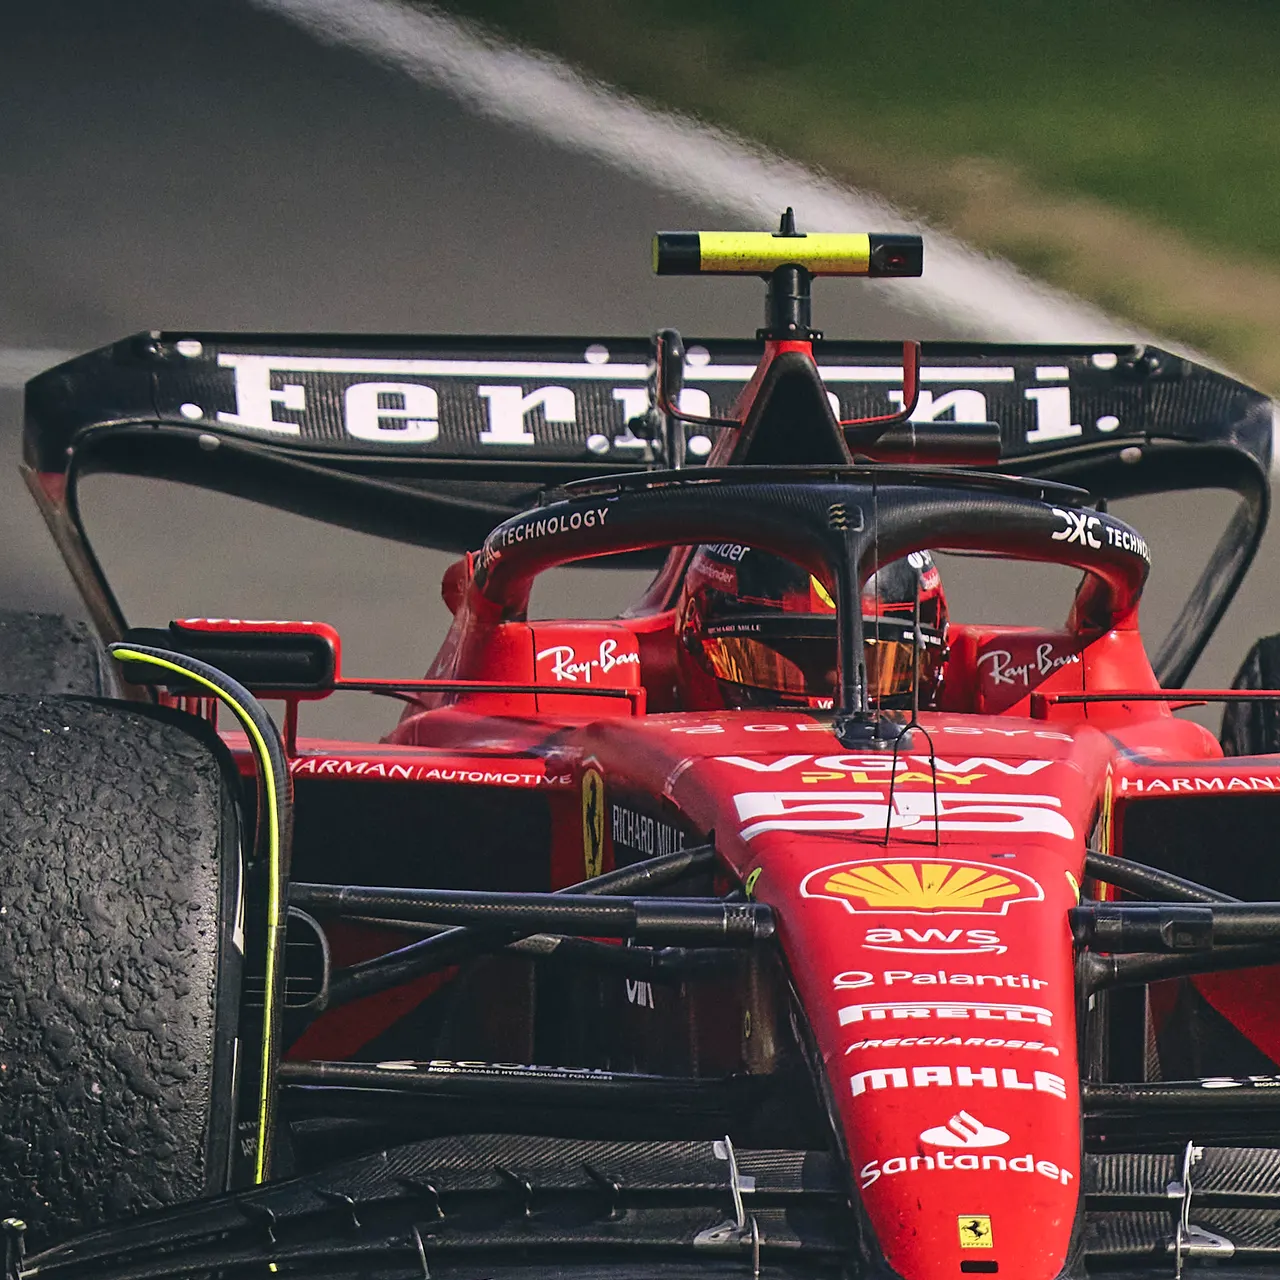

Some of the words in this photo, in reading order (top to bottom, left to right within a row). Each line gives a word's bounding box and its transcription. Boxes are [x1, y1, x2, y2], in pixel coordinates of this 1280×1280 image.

[217, 353, 1083, 447] Ferrri
[500, 507, 609, 546] TECHNOLOGY
[536, 639, 640, 683] Ray-Ban
[977, 643, 1079, 686] Ray-Ban
[426, 768, 572, 785] AUTOMOTIVE
[714, 754, 1056, 776] VGW
[801, 771, 988, 786] PLAY
[1121, 776, 1276, 791] HARMAN
[613, 804, 654, 855] RICHARD
[657, 821, 685, 857] MILLE
[733, 791, 1075, 842] 55
[864, 928, 1001, 944] aws
[884, 971, 1048, 990] Palantir
[838, 1001, 1053, 1027] PIRELLI
[844, 1036, 1060, 1056] FRECCIAROSSA
[850, 1065, 1067, 1099] MAHLE
[860, 1150, 1074, 1190] Santander
